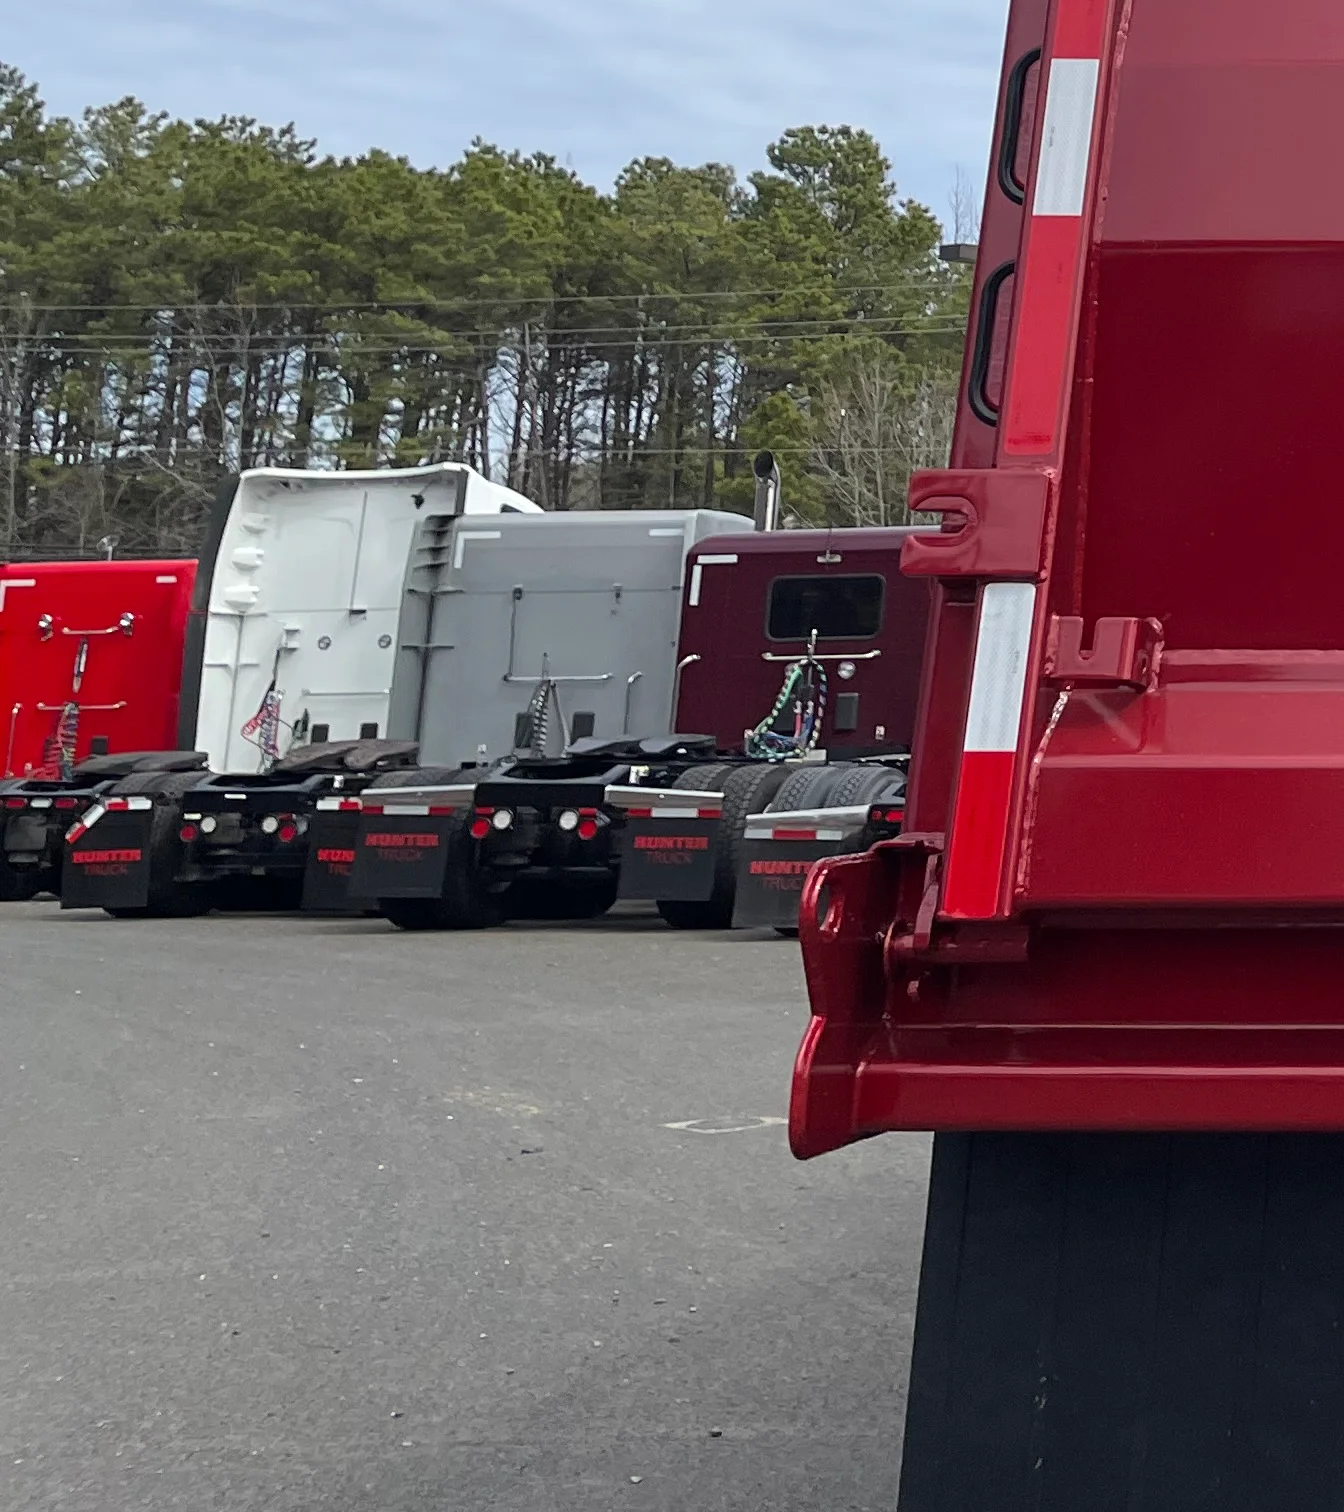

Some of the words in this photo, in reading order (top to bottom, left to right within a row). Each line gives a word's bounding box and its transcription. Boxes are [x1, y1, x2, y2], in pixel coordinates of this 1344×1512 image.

[365, 833, 439, 846] HUNTER
[633, 836, 709, 850] HUNTER
[72, 849, 142, 863] HUNTER
[317, 849, 355, 862] HUN
